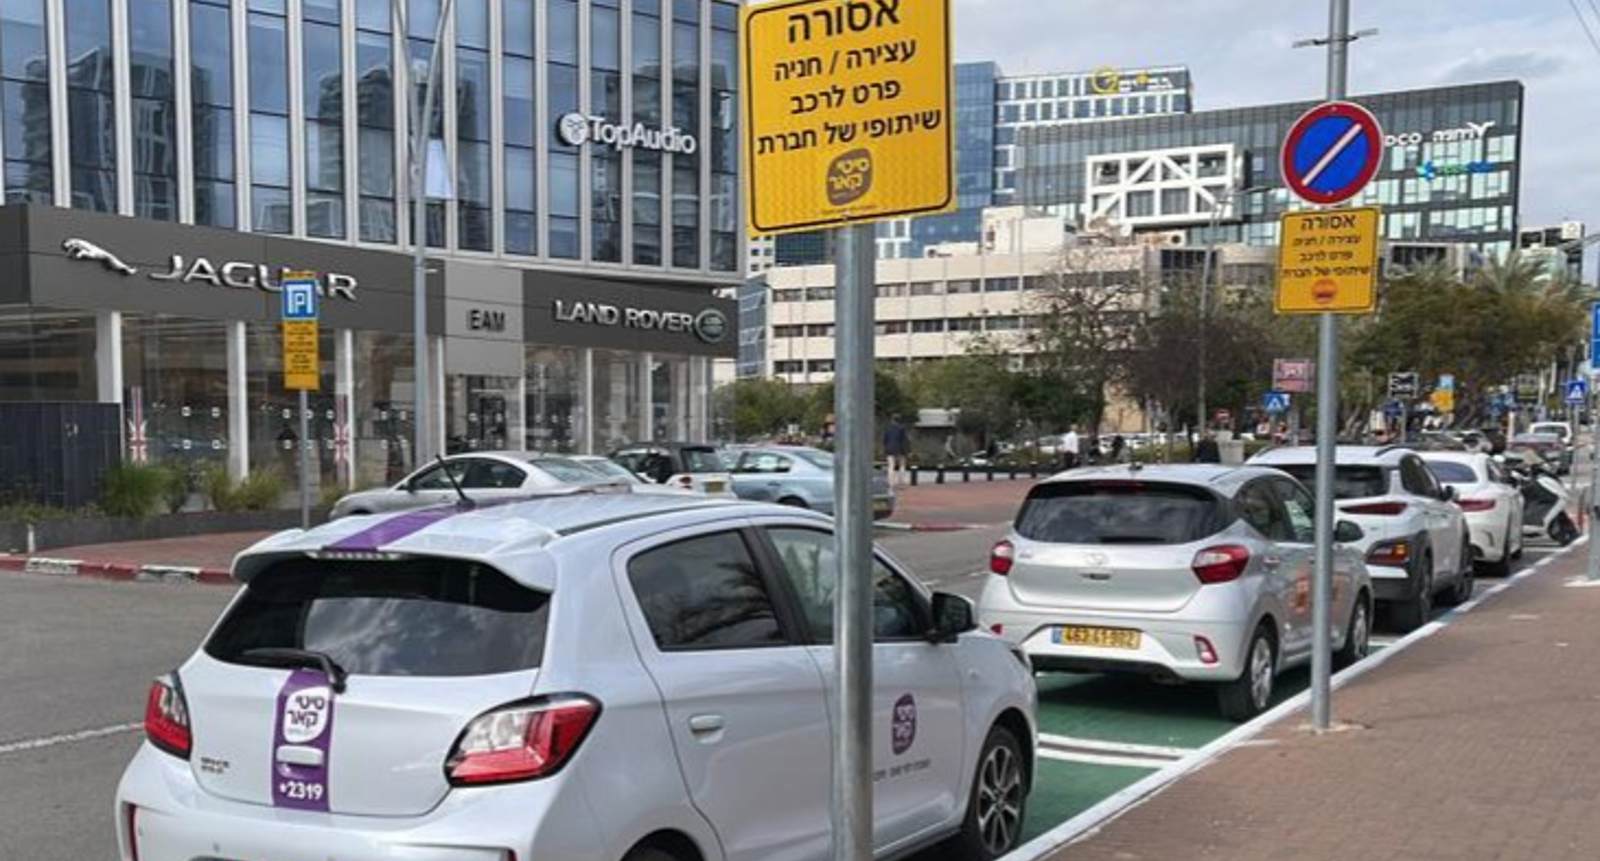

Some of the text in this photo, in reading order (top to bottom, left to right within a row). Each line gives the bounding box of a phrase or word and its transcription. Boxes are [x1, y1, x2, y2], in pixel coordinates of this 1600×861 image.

[788, 0, 900, 43] אסורה
[774, 39, 916, 81] עצירה / חניה
[790, 79, 901, 115] פרט לרכב
[588, 114, 697, 154] TopAudio
[757, 109, 942, 155] שיתופי של חברת
[1301, 214, 1357, 231] אסורה
[149, 255, 358, 300] JAGUR
[555, 300, 694, 332] LAND ROVER
[287, 709, 319, 729] קאר
[295, 695, 325, 711] סיטי
